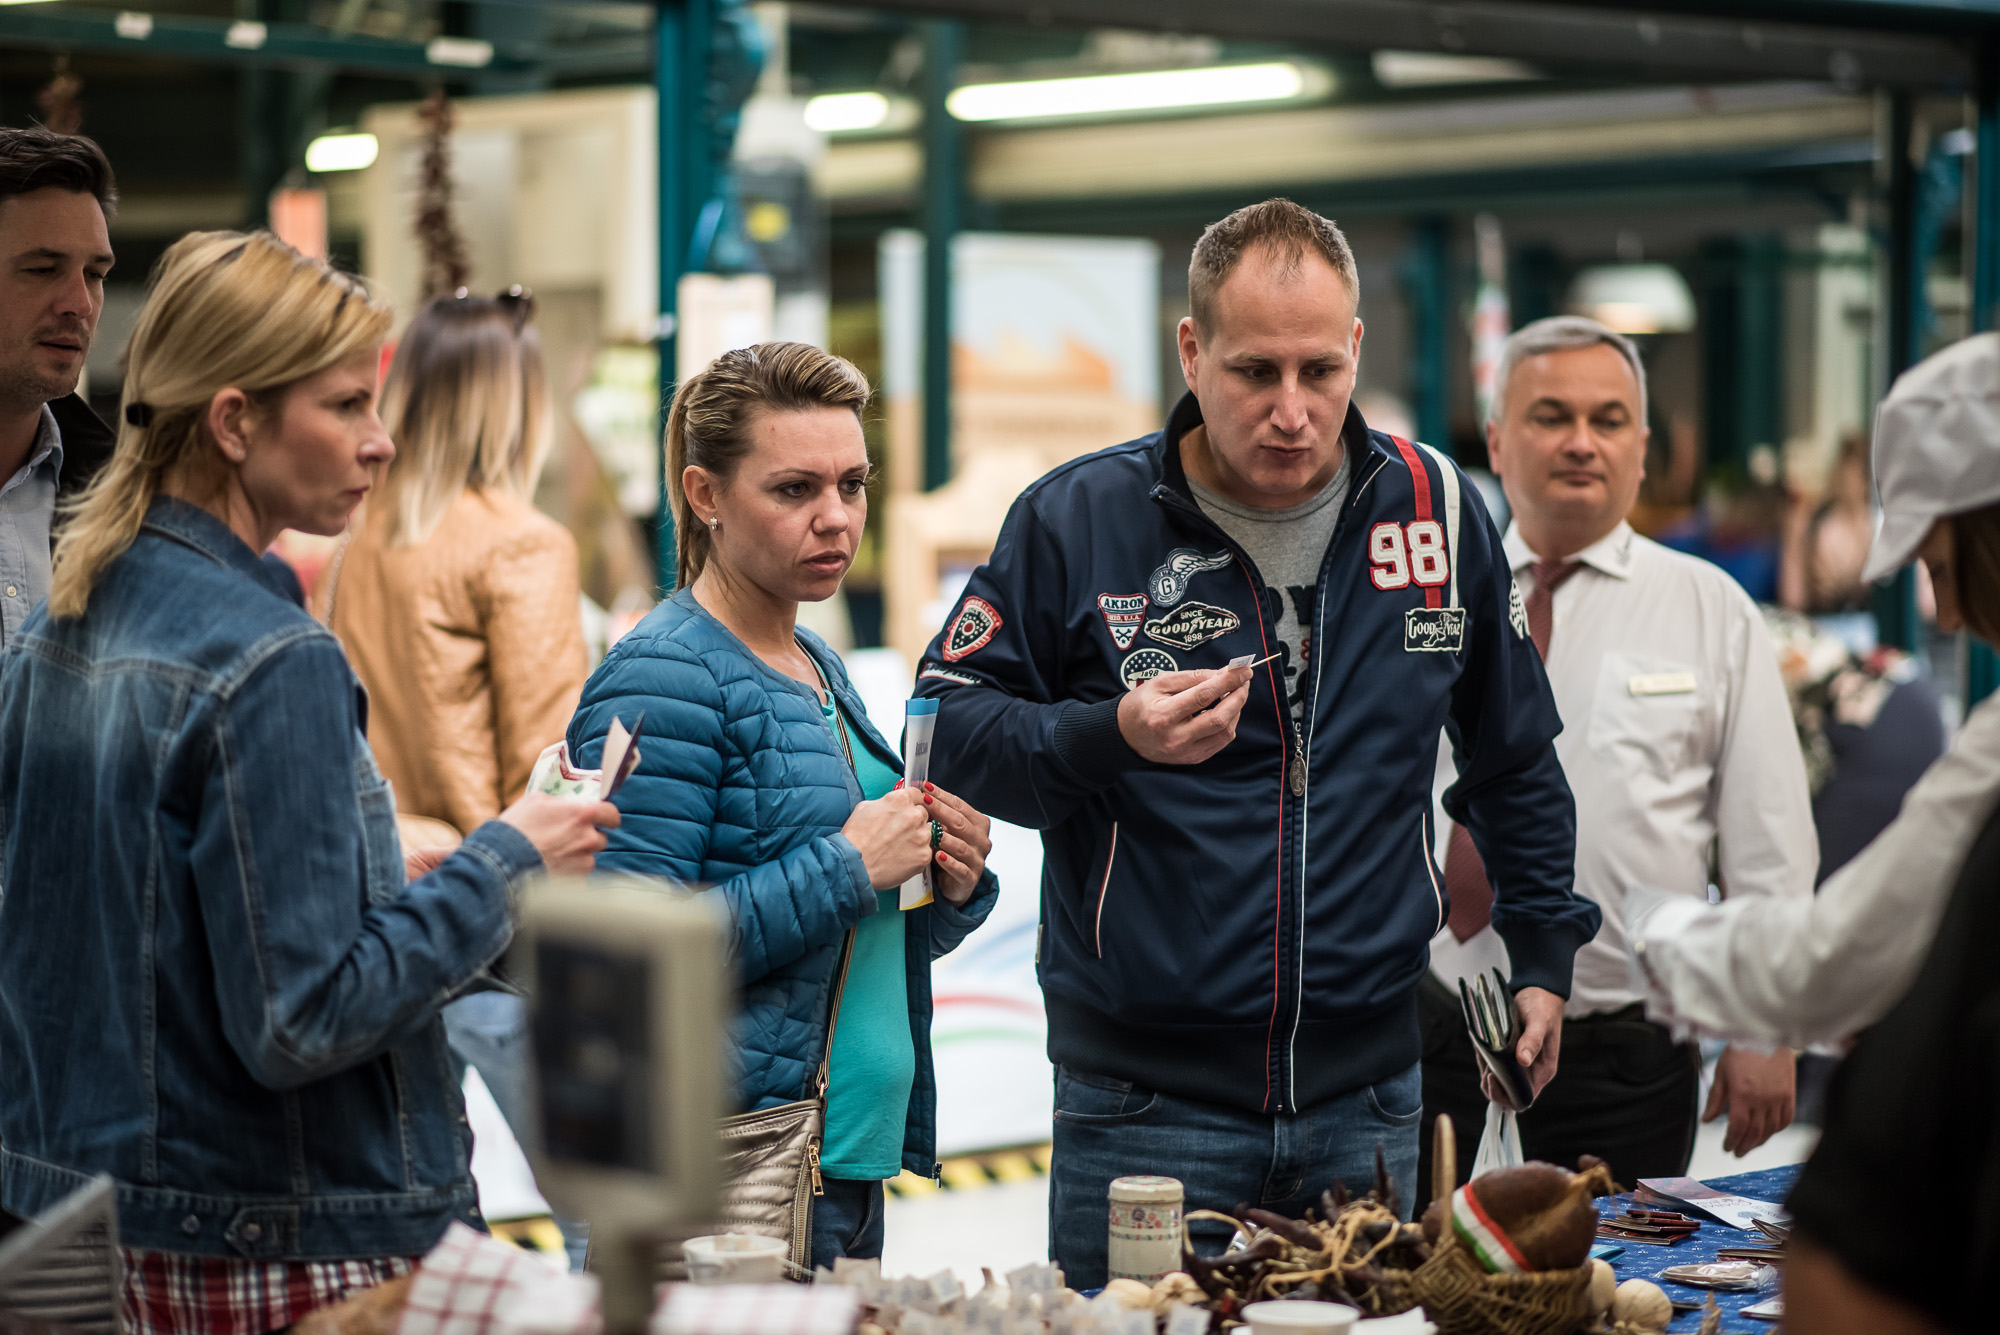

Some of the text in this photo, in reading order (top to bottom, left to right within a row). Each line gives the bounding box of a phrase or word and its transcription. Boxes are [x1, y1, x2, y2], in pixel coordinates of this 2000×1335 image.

[1369, 520, 1450, 591] 98
[1161, 577, 1172, 595] G
[1104, 597, 1144, 610] AKRON
[1180, 609, 1203, 619] SINCE
[1183, 632, 1203, 643] 1898
[1140, 669, 1160, 678] 1898
